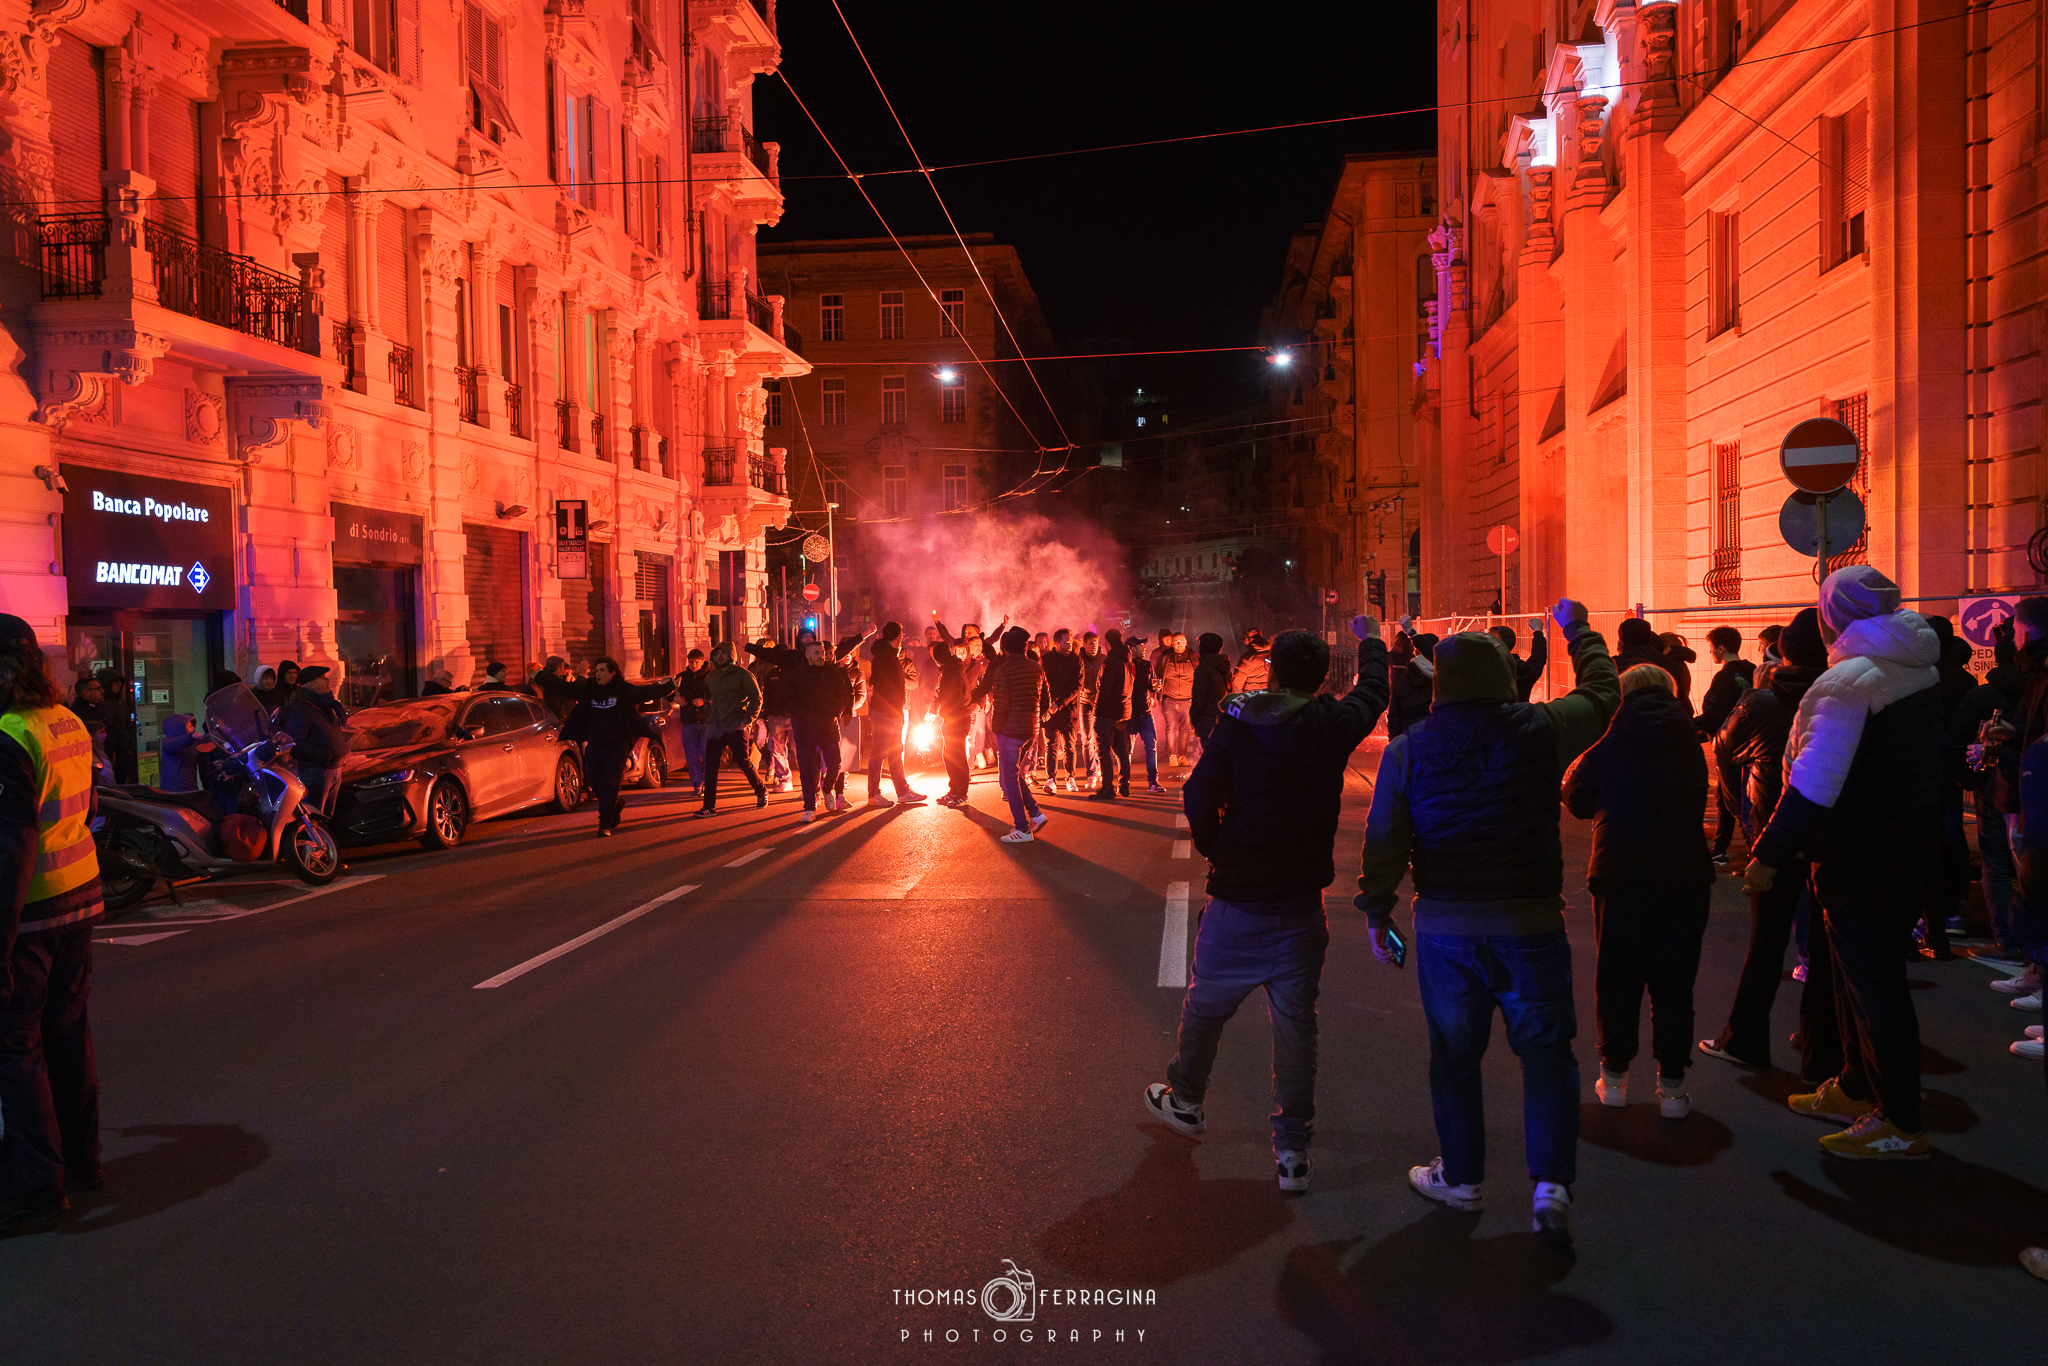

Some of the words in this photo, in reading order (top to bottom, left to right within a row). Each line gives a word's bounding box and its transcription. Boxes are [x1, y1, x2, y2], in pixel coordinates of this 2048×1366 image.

[92, 491, 141, 515] Banca
[144, 497, 209, 523] Popolare
[560, 502, 581, 538] T
[350, 523, 358, 537] di
[362, 525, 397, 542] Sondrio
[96, 561, 184, 586] BANCOMAT
[1972, 650, 1993, 658] PED
[1974, 661, 1998, 670] SINIS
[48, 716, 81, 739] polizia
